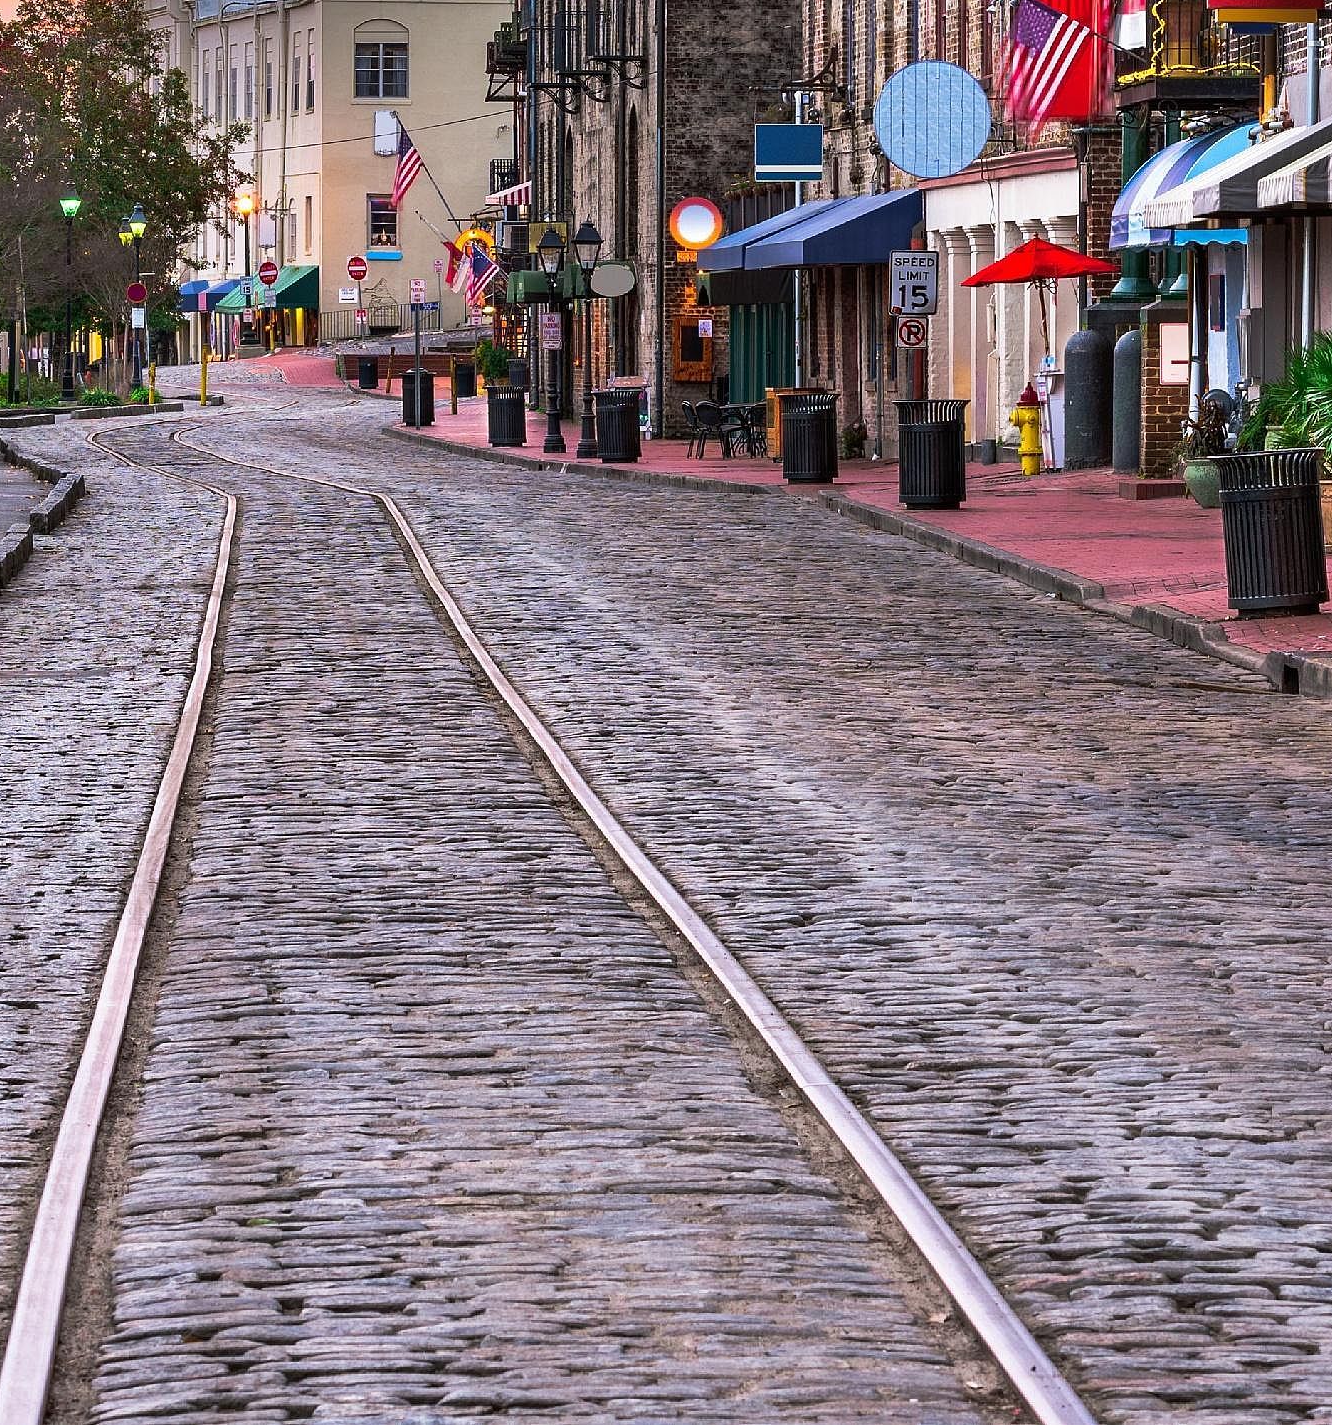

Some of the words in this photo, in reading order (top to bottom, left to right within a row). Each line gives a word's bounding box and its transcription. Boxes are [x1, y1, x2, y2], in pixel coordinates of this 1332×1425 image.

[894, 257, 935, 267] SPEED
[898, 271, 930, 281] LIMIT
[242, 286, 251, 294] 15
[898, 285, 929, 309] 15
